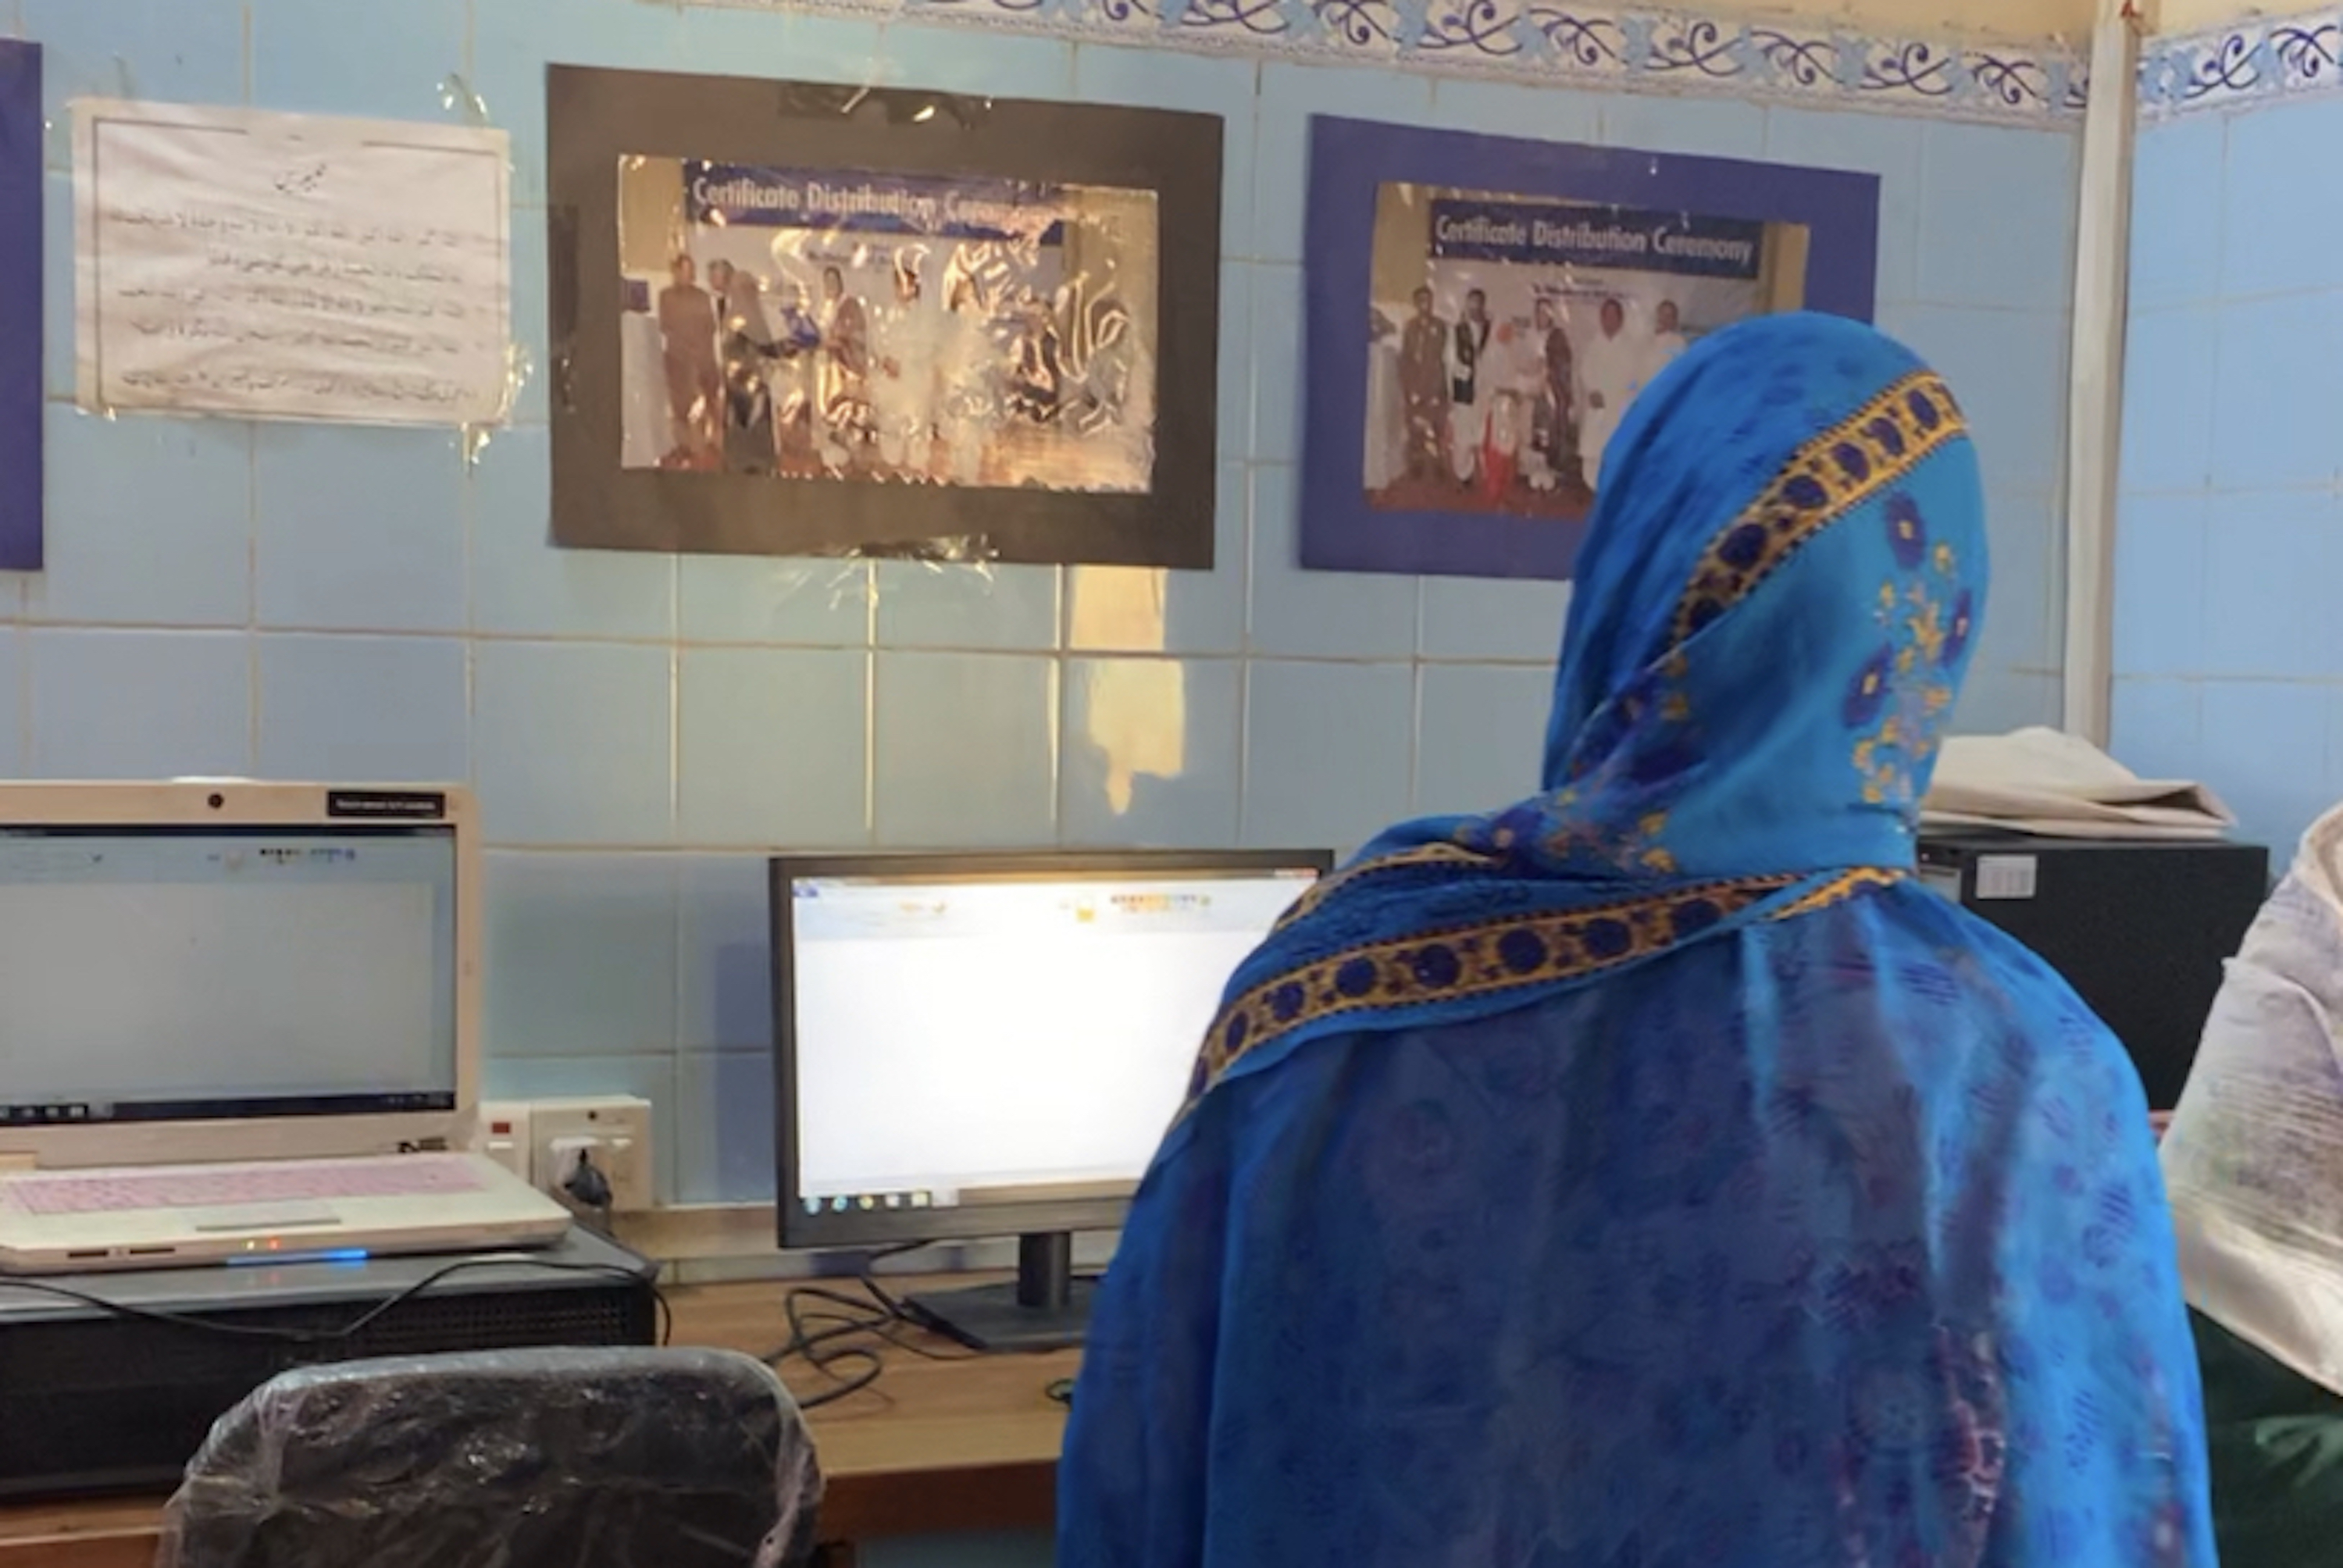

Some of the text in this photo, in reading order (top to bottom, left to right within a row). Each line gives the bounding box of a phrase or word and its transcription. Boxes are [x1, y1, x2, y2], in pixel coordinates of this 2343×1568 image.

[693, 176, 800, 209] Certificate
[806, 180, 936, 216] Distribution
[1435, 215, 1753, 265] Certificate Distribution Ceremony
